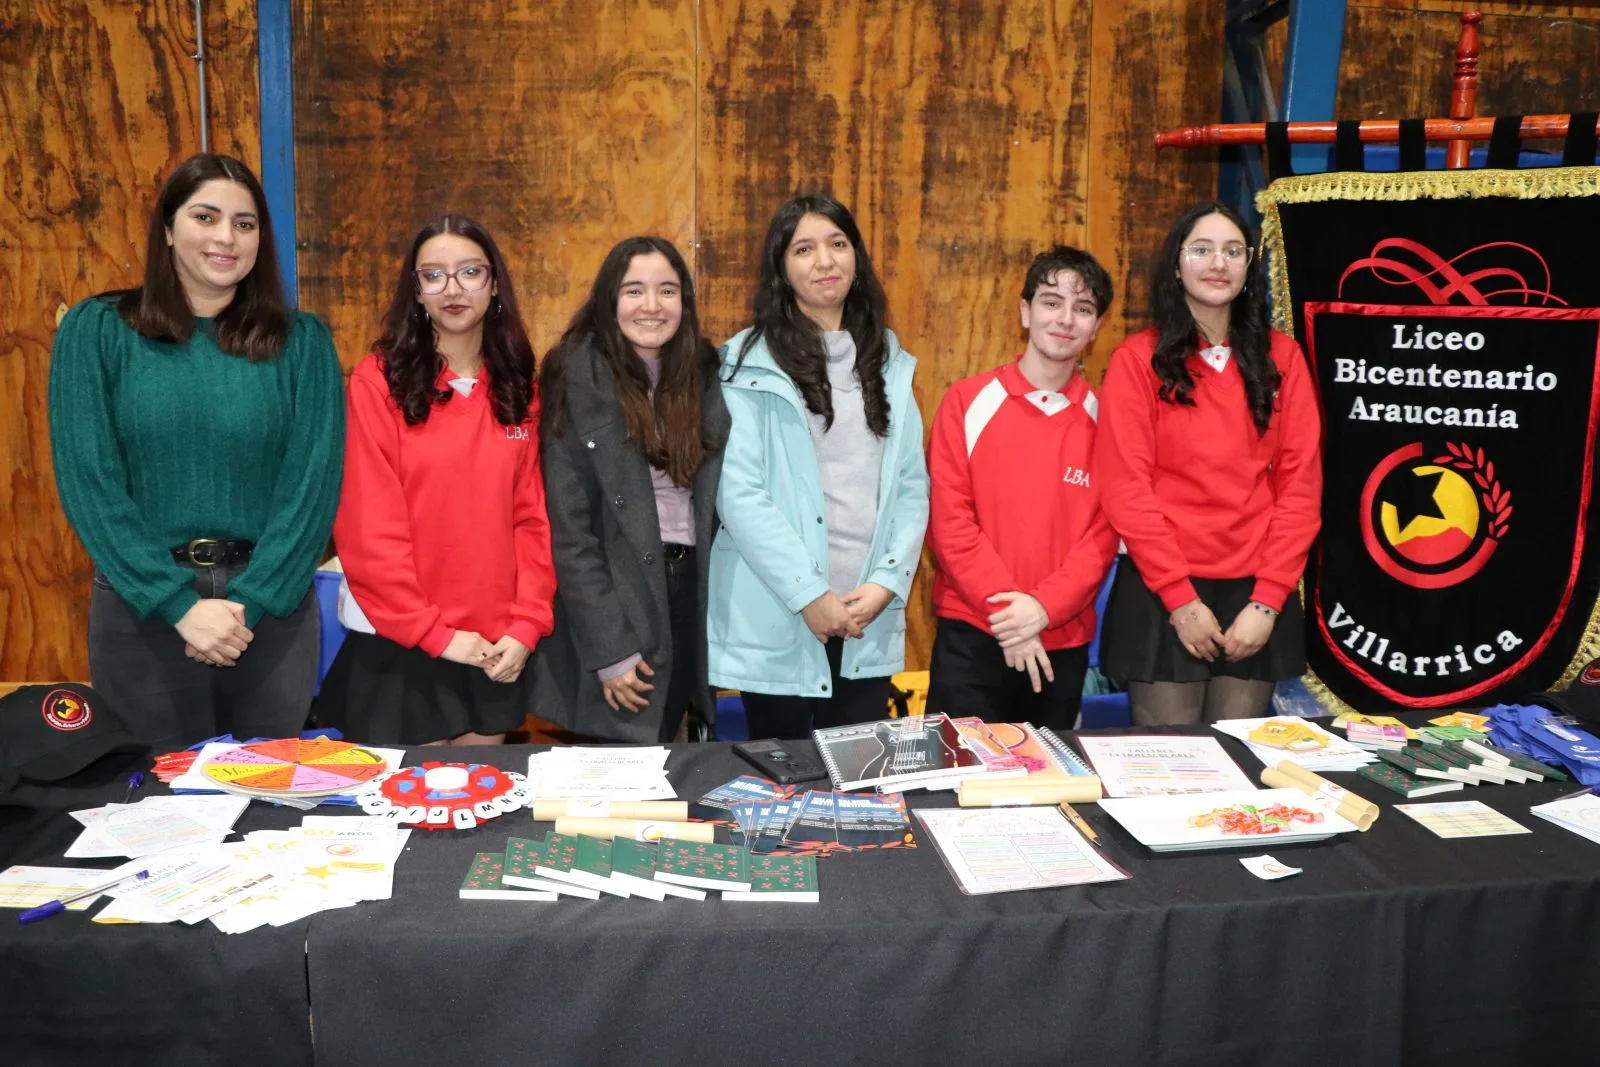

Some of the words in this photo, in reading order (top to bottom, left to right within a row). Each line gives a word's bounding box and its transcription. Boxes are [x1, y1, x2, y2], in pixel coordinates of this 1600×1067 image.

[1392, 324, 1485, 351] Liceo
[1334, 358, 1558, 392] Bicentenario
[1348, 396, 1519, 429] Araucanía
[505, 426, 530, 441] LBA
[1063, 466, 1090, 488] LBA
[1328, 602, 1524, 676] Villarrica
[433, 809, 443, 818] J
[460, 813, 468, 821] L
[481, 804, 495, 812] M
